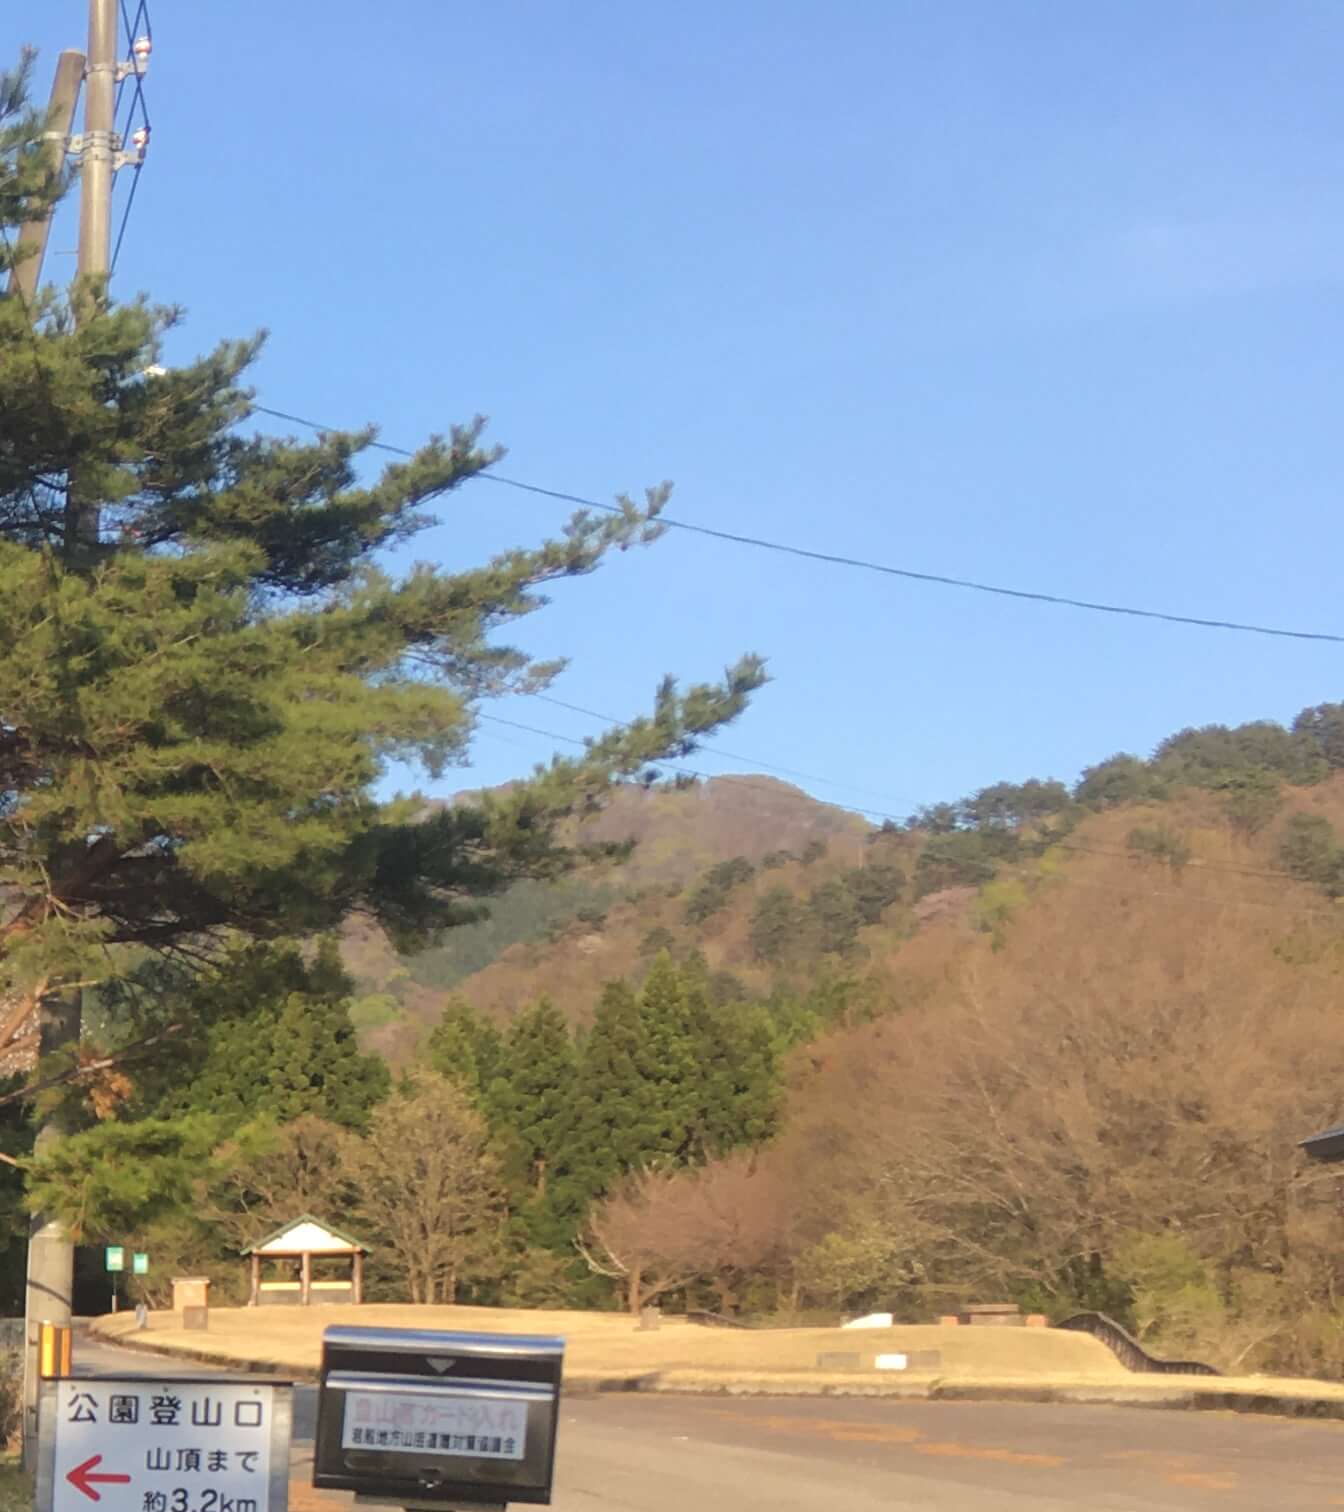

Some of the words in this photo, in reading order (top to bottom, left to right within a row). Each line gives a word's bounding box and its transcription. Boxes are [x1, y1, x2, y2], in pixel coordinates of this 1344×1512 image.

[68, 1393, 262, 1427] 公園登山口
[146, 1447, 259, 1472] 山頂まで
